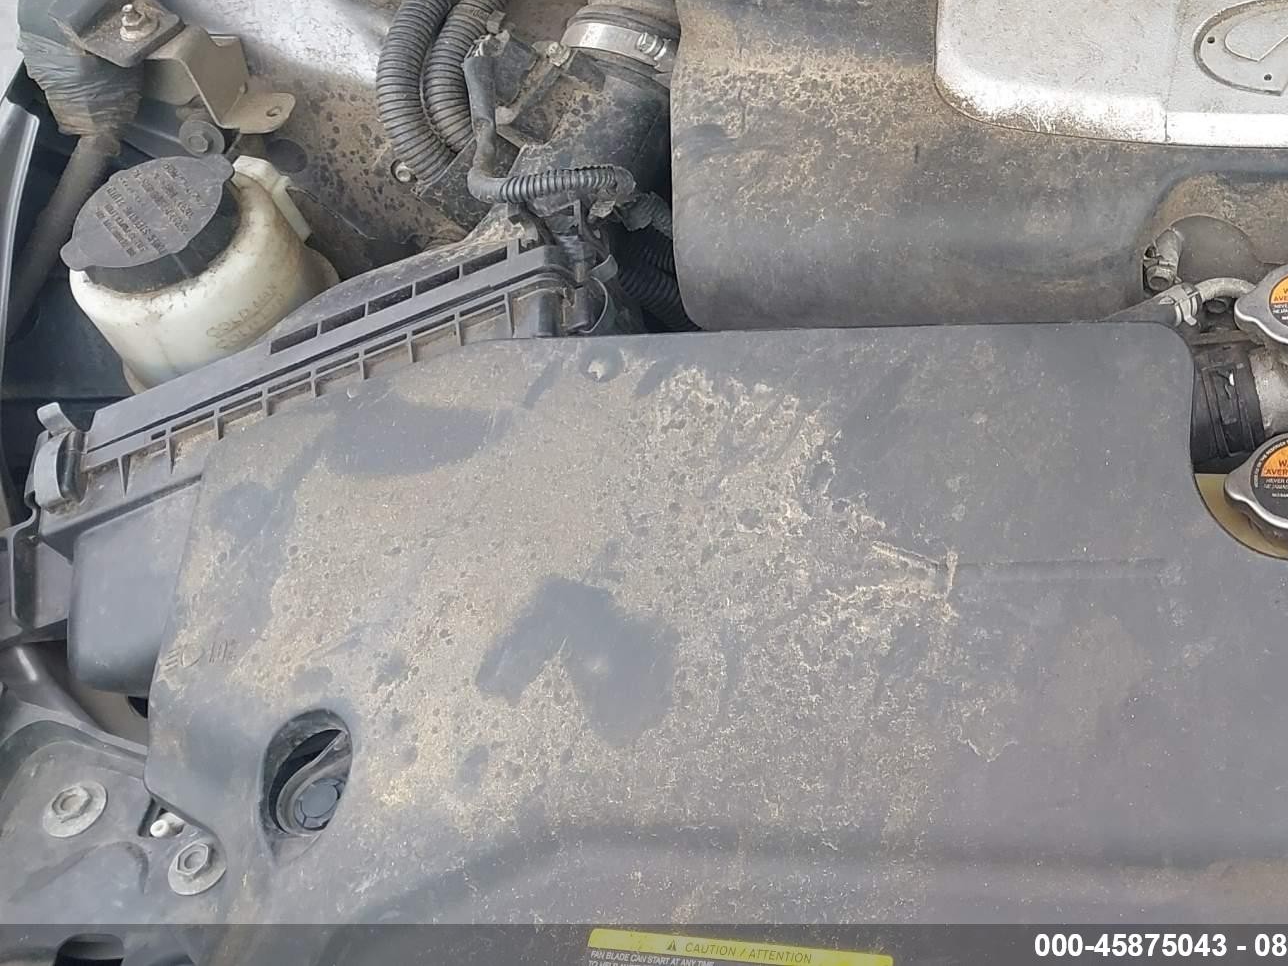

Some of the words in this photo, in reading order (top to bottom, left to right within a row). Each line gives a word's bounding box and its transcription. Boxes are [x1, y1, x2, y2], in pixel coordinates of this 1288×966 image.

[590, 950, 604, 959] FAN
[605, 952, 630, 962] BLADE
[631, 954, 646, 962] CAN
[648, 956, 670, 965] START
[685, 942, 737, 957] CAUTION
[749, 949, 812, 964] ATTENTION
